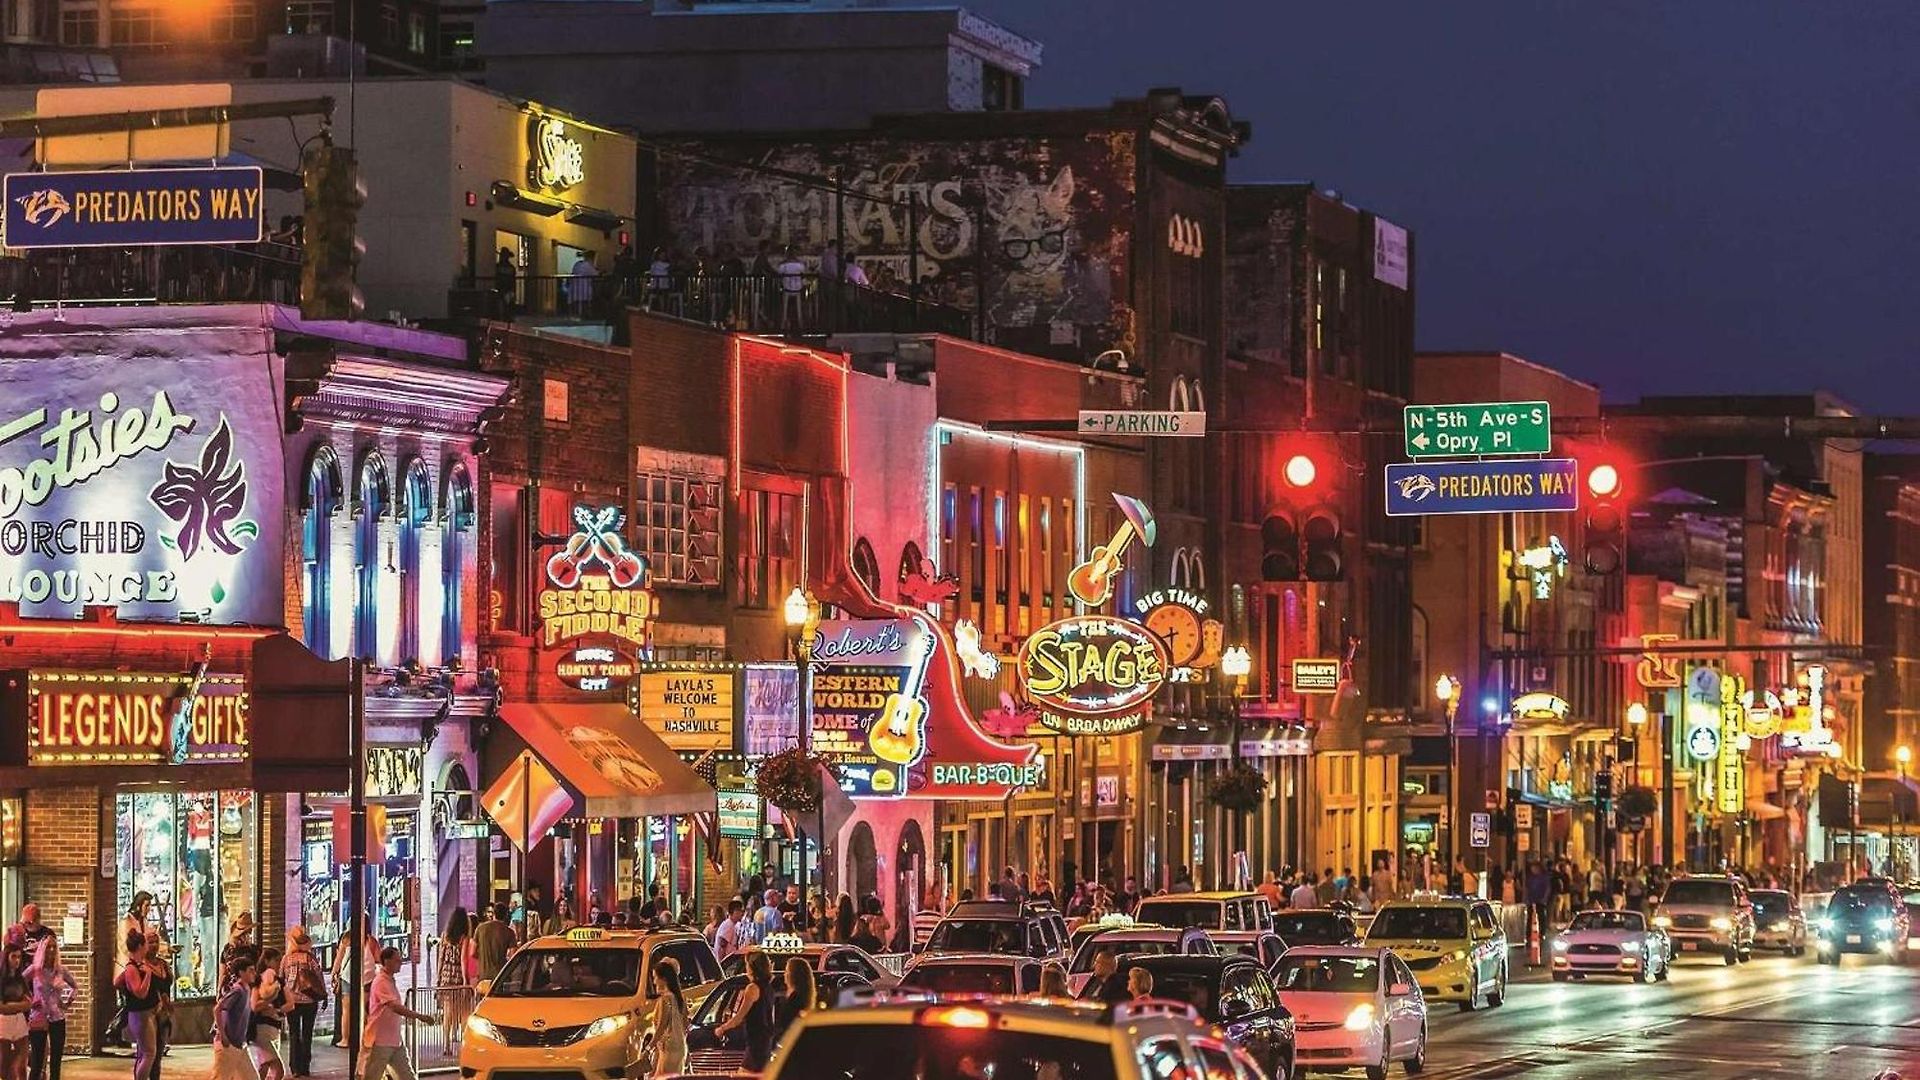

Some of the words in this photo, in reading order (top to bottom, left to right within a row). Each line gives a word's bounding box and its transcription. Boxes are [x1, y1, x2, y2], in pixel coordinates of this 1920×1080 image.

[75, 189, 201, 223] PREDATORS
[210, 187, 259, 220] WAY
[1103, 413, 1181, 434] PARKING
[1410, 411, 1468, 429] N-5th
[1480, 408, 1543, 428] Ave-S
[1436, 432, 1478, 453] Opry
[1492, 431, 1513, 448] Pl
[1439, 473, 1534, 499] PREDATORS
[1540, 471, 1575, 495] WAY
[1, 518, 145, 558] ORCHID
[0, 570, 177, 604] LOUNGE
[540, 589, 649, 619] SECOND
[1136, 591, 1163, 613] BIG
[1167, 588, 1208, 613] TIME
[545, 612, 645, 646] FIDDLE
[557, 664, 596, 677] HONKY
[599, 664, 632, 676] TONK
[1027, 631, 1163, 695] STAGE
[666, 679, 714, 691] LAYLA'S
[813, 675, 900, 691] ESTERN
[663, 693, 718, 705] WELCOME
[42, 693, 164, 747] LEGENDS
[191, 695, 246, 746] GIFTS
[683, 706, 696, 718] TO
[1042, 711, 1060, 728] ON
[1067, 713, 1141, 732] BROADWAY
[664, 720, 720, 733] NASHVILLE
[813, 714, 858, 730] OME
[860, 713, 875, 733] of
[933, 763, 1038, 786] BAR-B-QUE
[572, 931, 602, 940] YELLOW
[765, 939, 799, 948] TAXI
